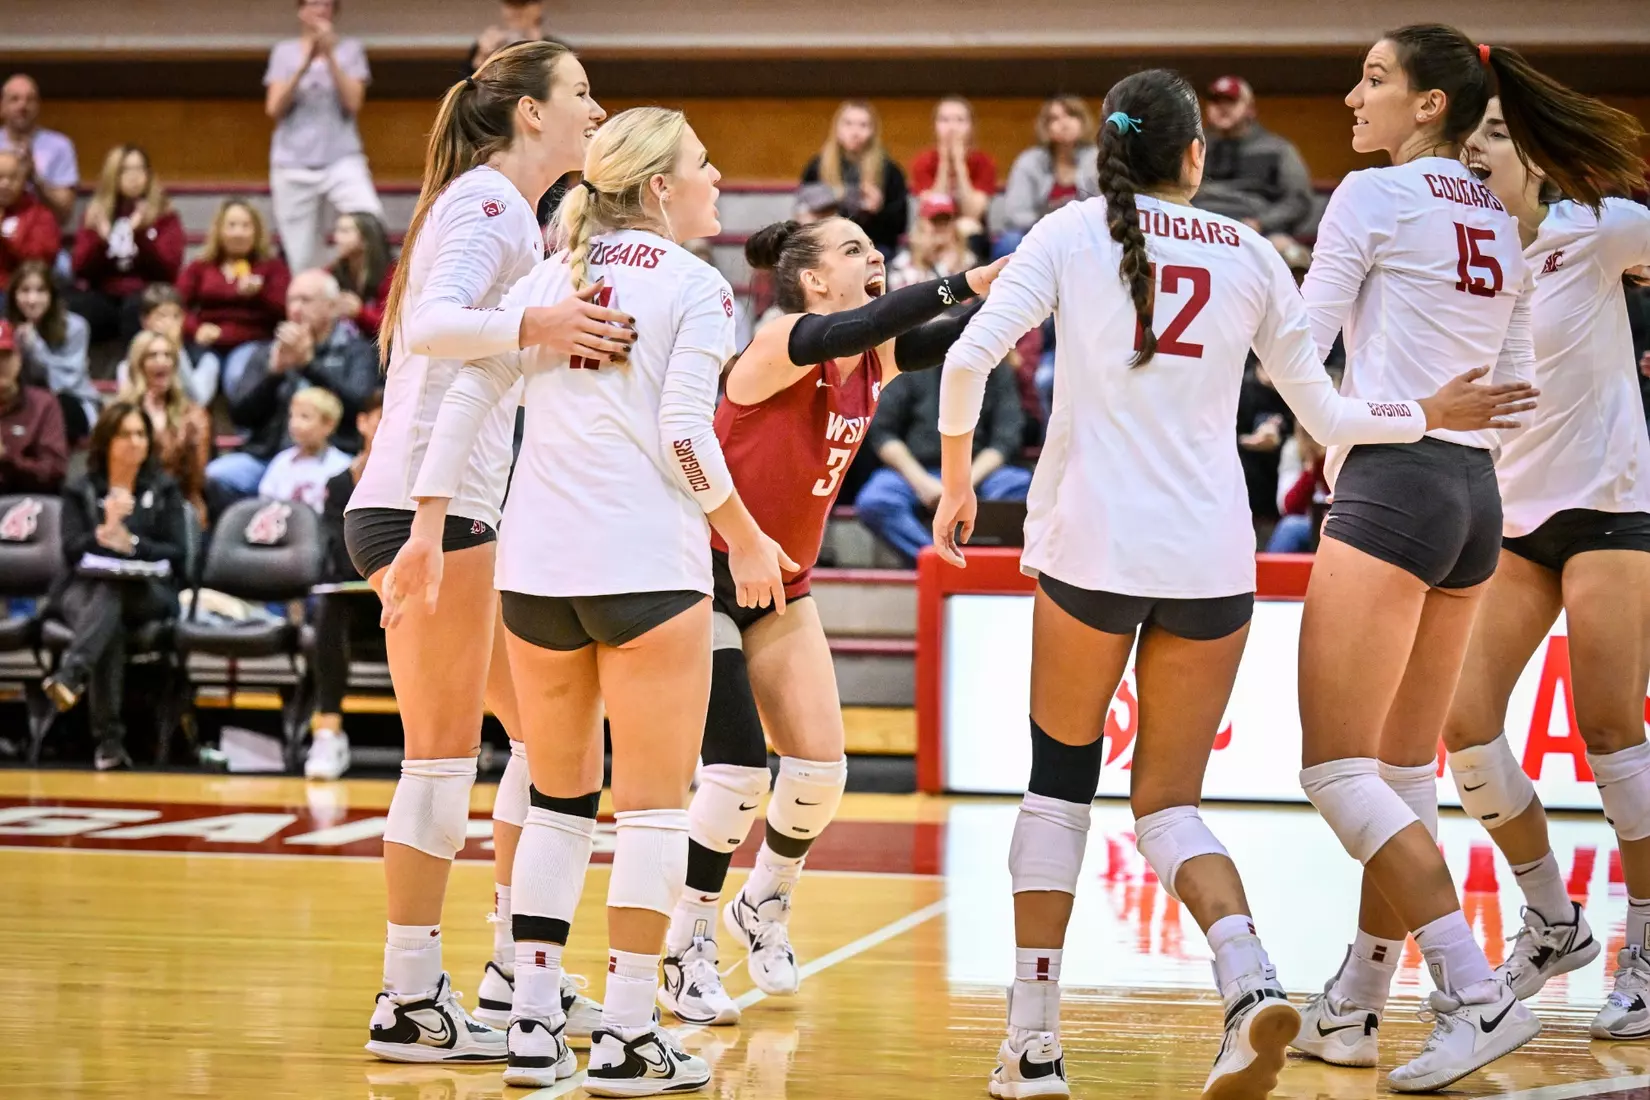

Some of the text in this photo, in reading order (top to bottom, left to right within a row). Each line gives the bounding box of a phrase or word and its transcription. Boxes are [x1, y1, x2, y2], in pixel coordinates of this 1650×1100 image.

[1422, 174, 1504, 212] COUGARS
[1136, 208, 1240, 248] OUGARS
[561, 242, 667, 269] UGARS
[1453, 221, 1504, 298] 15
[673, 438, 711, 493] COUGARS
[811, 447, 852, 497] 3
